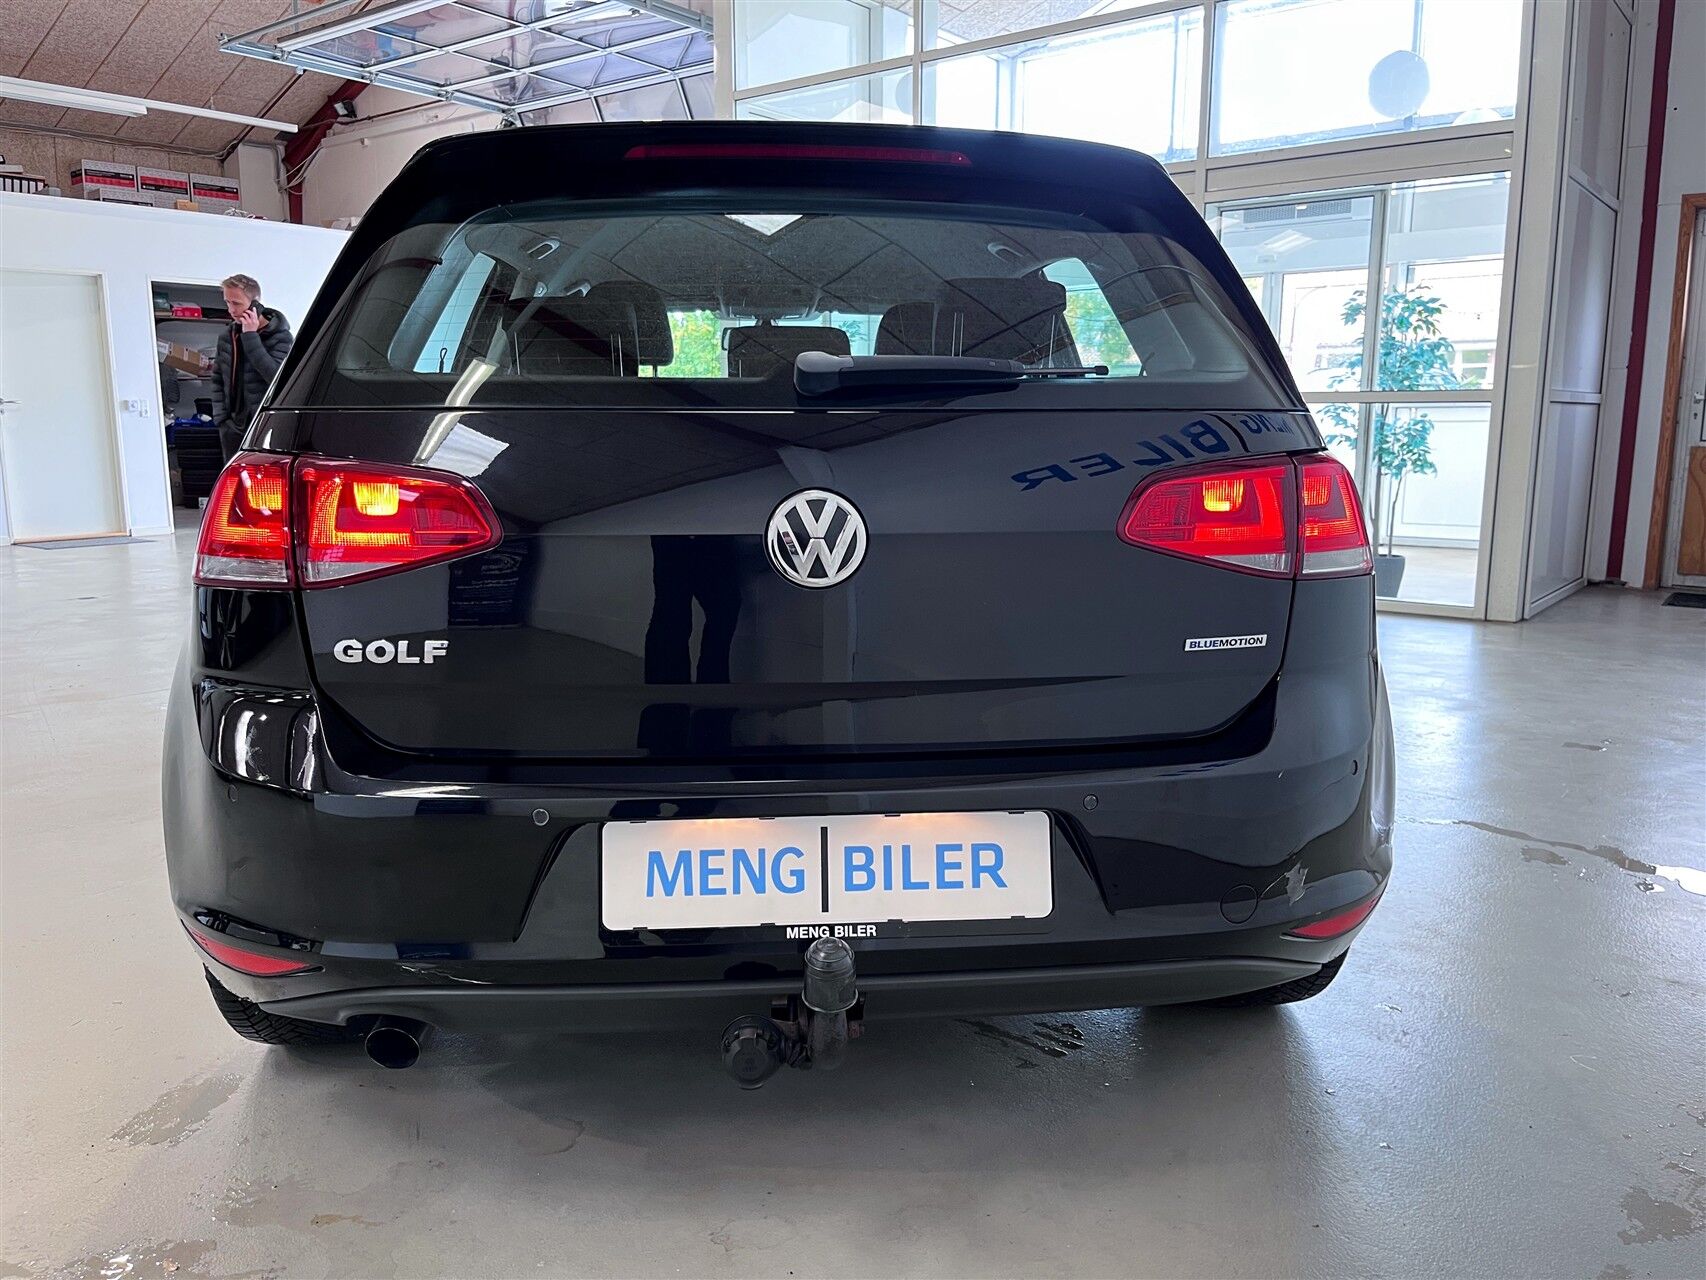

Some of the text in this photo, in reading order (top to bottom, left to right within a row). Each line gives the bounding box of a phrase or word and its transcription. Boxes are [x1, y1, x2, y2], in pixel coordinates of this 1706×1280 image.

[333, 639, 449, 664] GOLF
[1189, 637, 1264, 649] BLUEMOTION
[645, 842, 1009, 898] MENG BILER
[786, 924, 877, 939] MENG BILER
